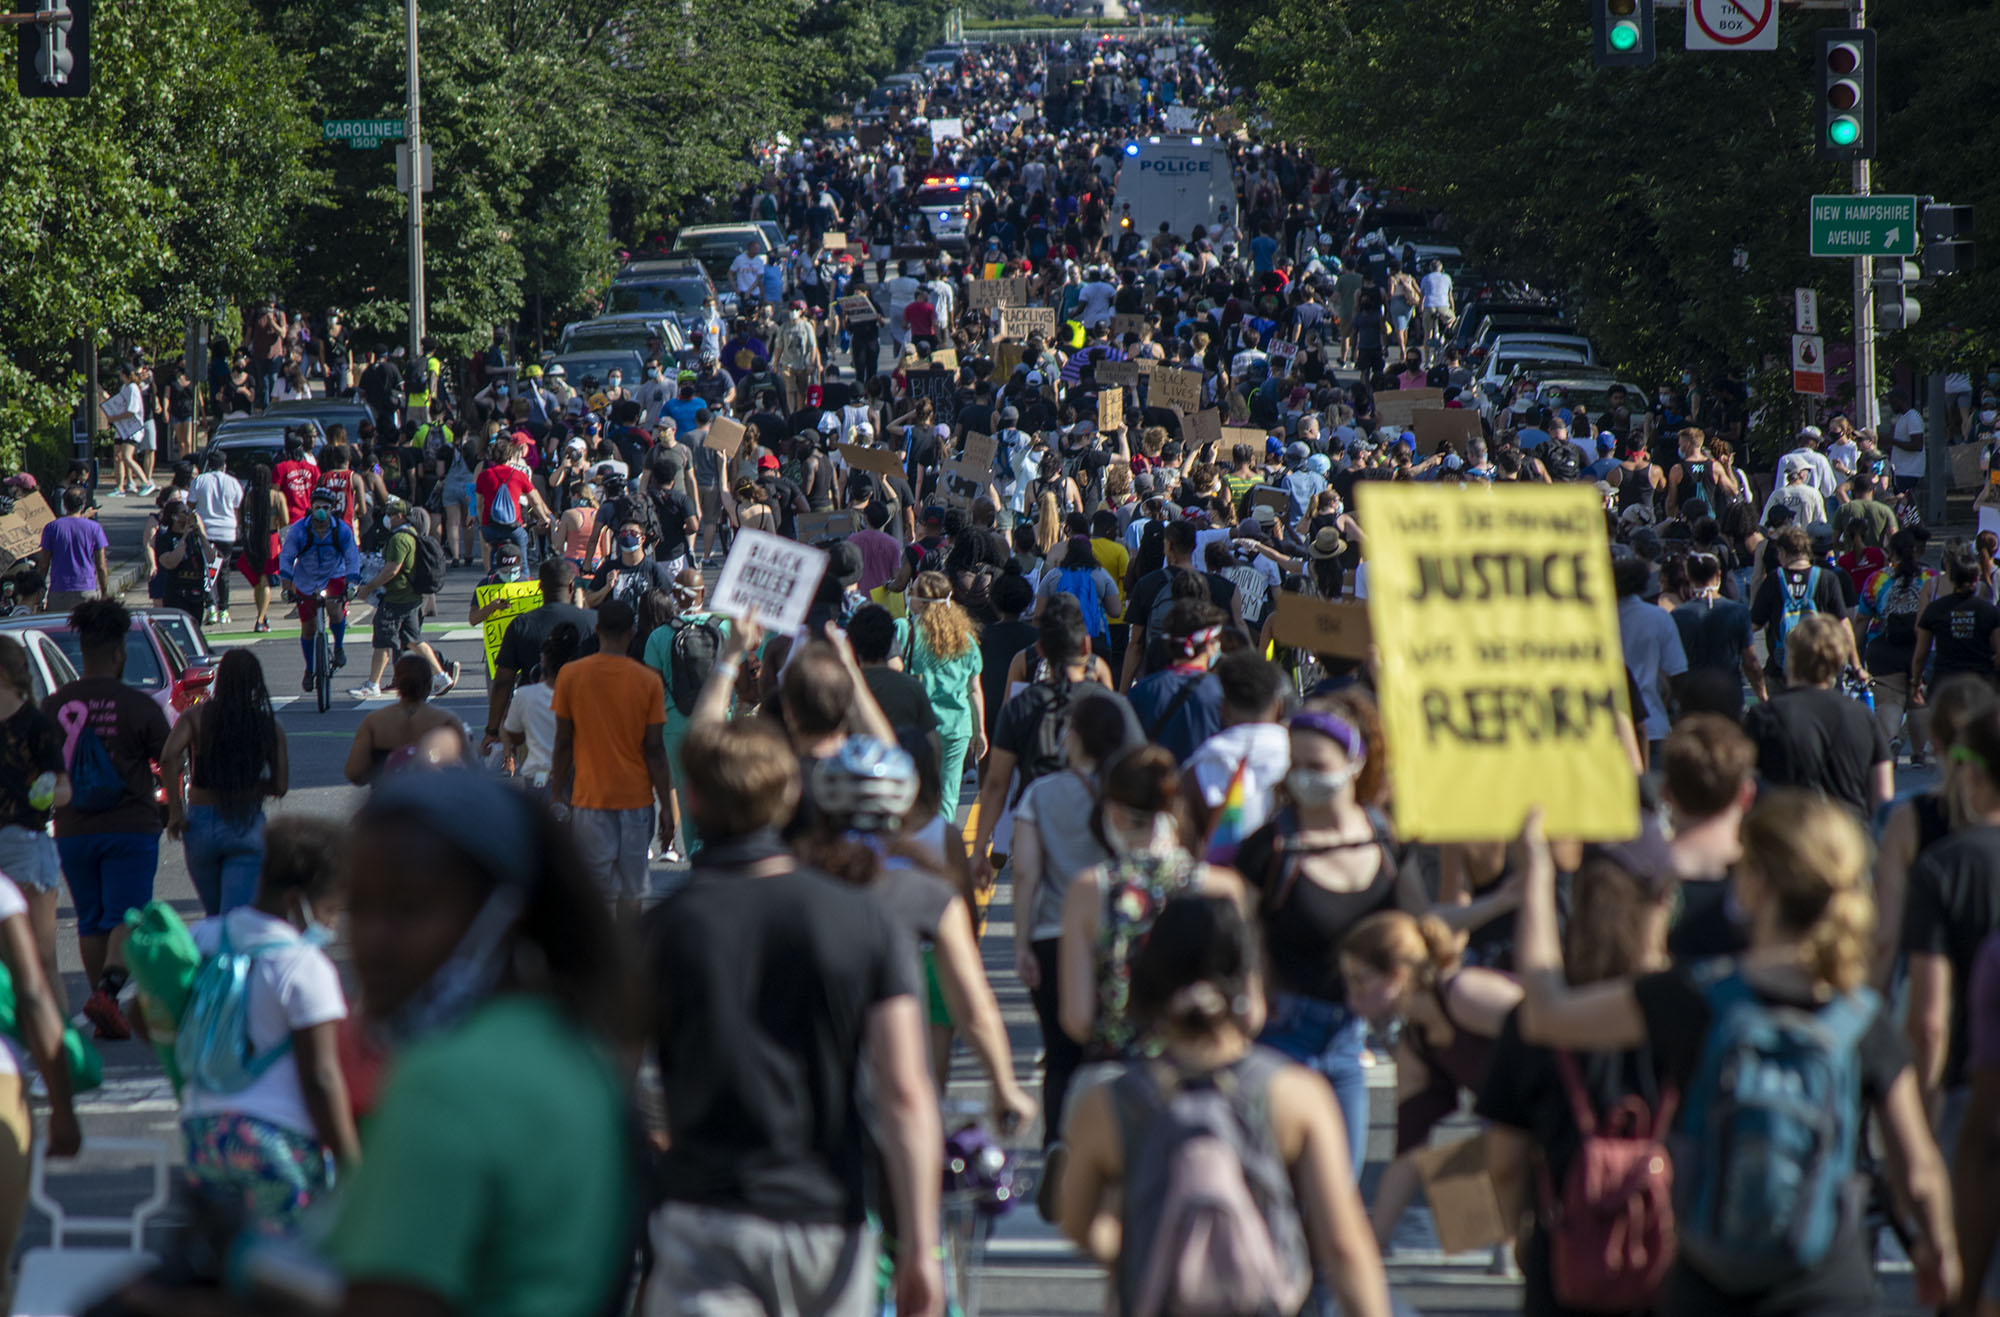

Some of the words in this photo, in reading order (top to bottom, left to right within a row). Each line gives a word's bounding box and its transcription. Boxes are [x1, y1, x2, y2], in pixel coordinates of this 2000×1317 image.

[1720, 20, 1743, 30] BOX
[325, 122, 392, 137] CAROLINE
[352, 137, 378, 148] 1500
[1140, 160, 1210, 172] POLICE
[1815, 205, 1841, 221] NEW
[1845, 205, 1910, 221] HAMPSHIRE
[1827, 230, 1871, 245] AVENUE
[975, 296, 1020, 306] MATER
[1004, 308, 1028, 322] LACK
[1029, 309, 1054, 323] LIVES
[1007, 321, 1049, 336] MATTER
[1154, 370, 1188, 387] BLACK
[1162, 385, 1194, 400] LIVES
[1395, 509, 1440, 533] WE
[1460, 505, 1593, 534] DEMAND
[750, 542, 806, 573] BLACK
[1409, 552, 1597, 605] JUSTICE
[1409, 643, 1454, 666] WE
[1476, 640, 1604, 666] DEMAND
[1421, 686, 1622, 745] REFORM
